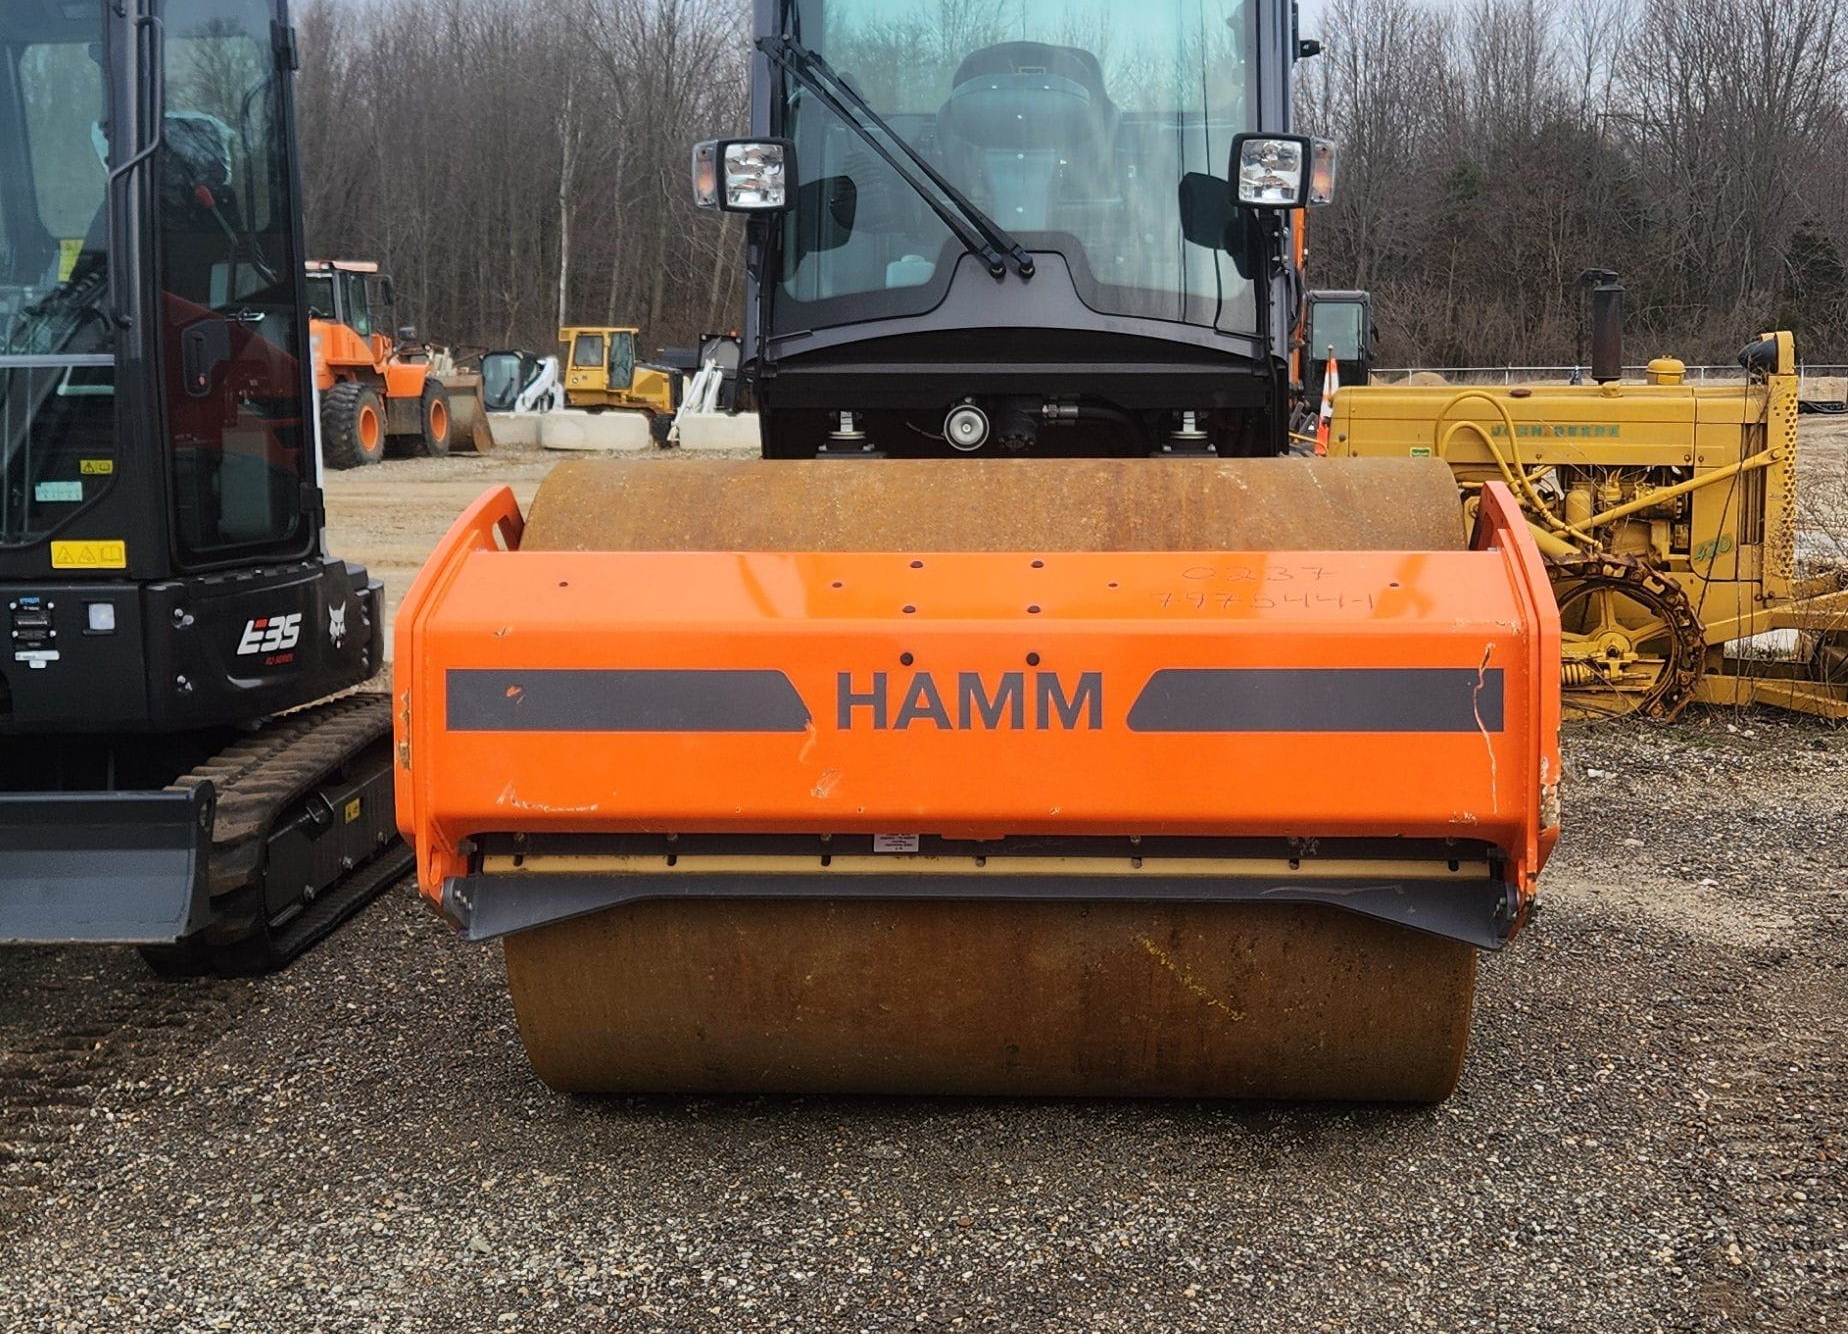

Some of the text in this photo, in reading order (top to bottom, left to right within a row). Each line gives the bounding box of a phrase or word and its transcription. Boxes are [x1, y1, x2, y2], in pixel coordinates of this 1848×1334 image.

[1181, 566, 1338, 582] 0237
[236, 612, 303, 656] E35
[837, 671, 1104, 731] HAMM
